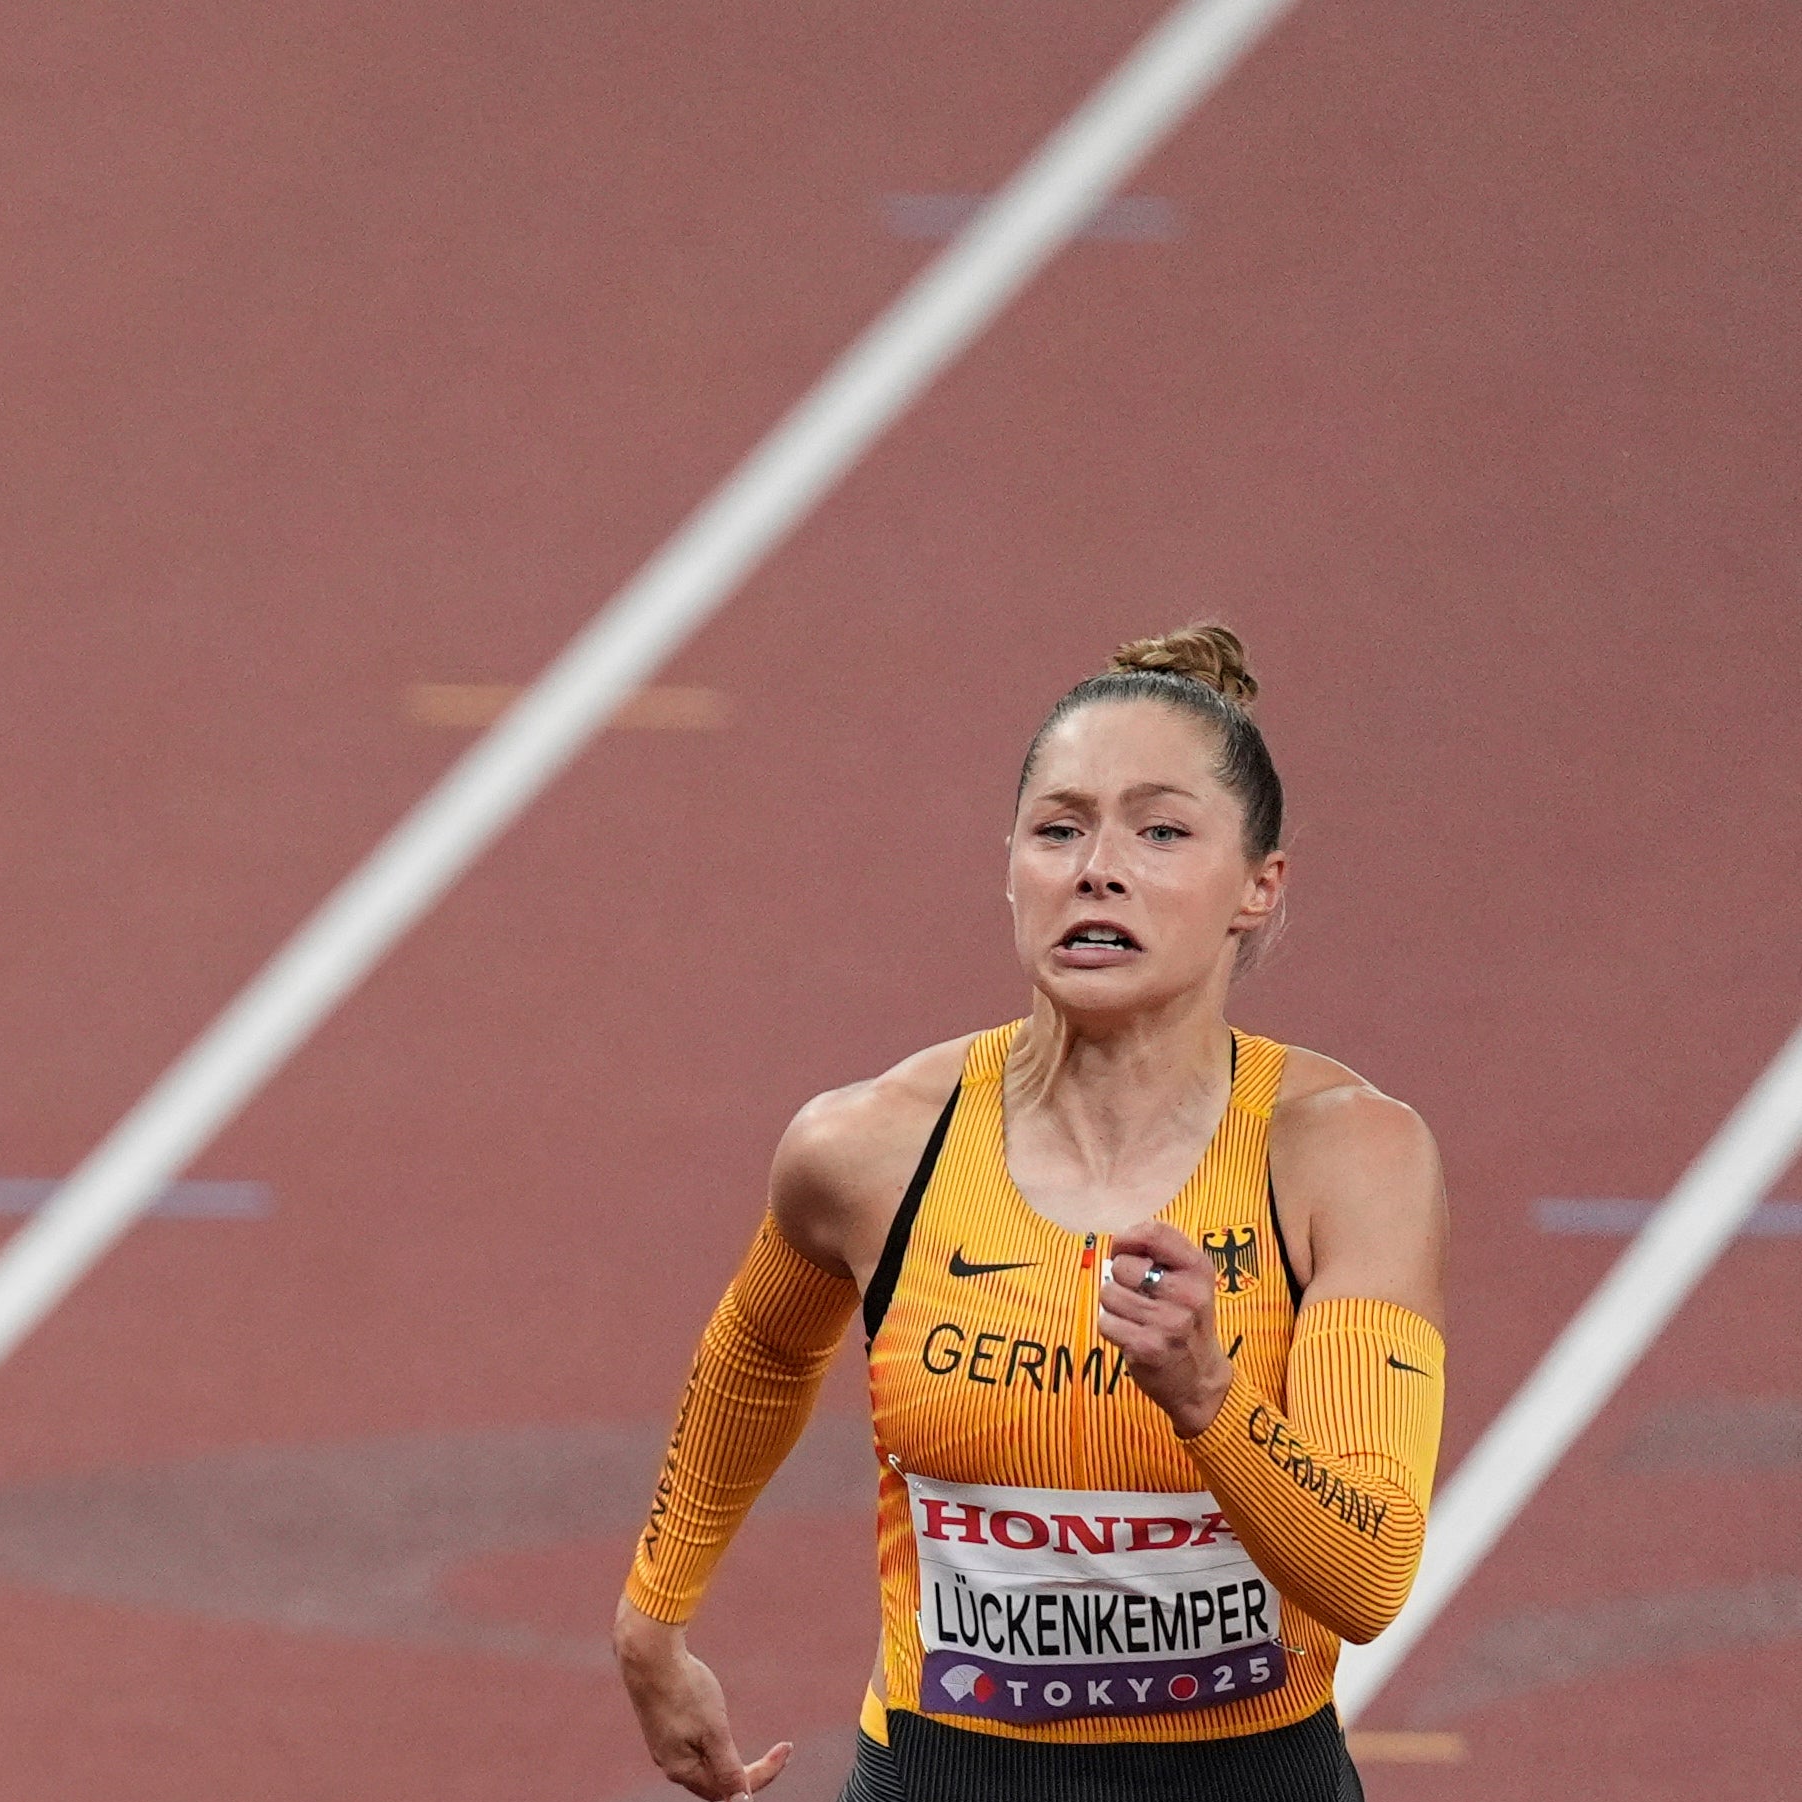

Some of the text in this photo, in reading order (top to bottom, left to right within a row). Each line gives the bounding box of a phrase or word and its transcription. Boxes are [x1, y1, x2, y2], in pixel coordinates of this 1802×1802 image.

[921, 1321, 1245, 1397] GERM
[918, 1497, 1243, 1556] HONDA
[934, 1573, 1271, 1658] LÜCKENKEMPER
